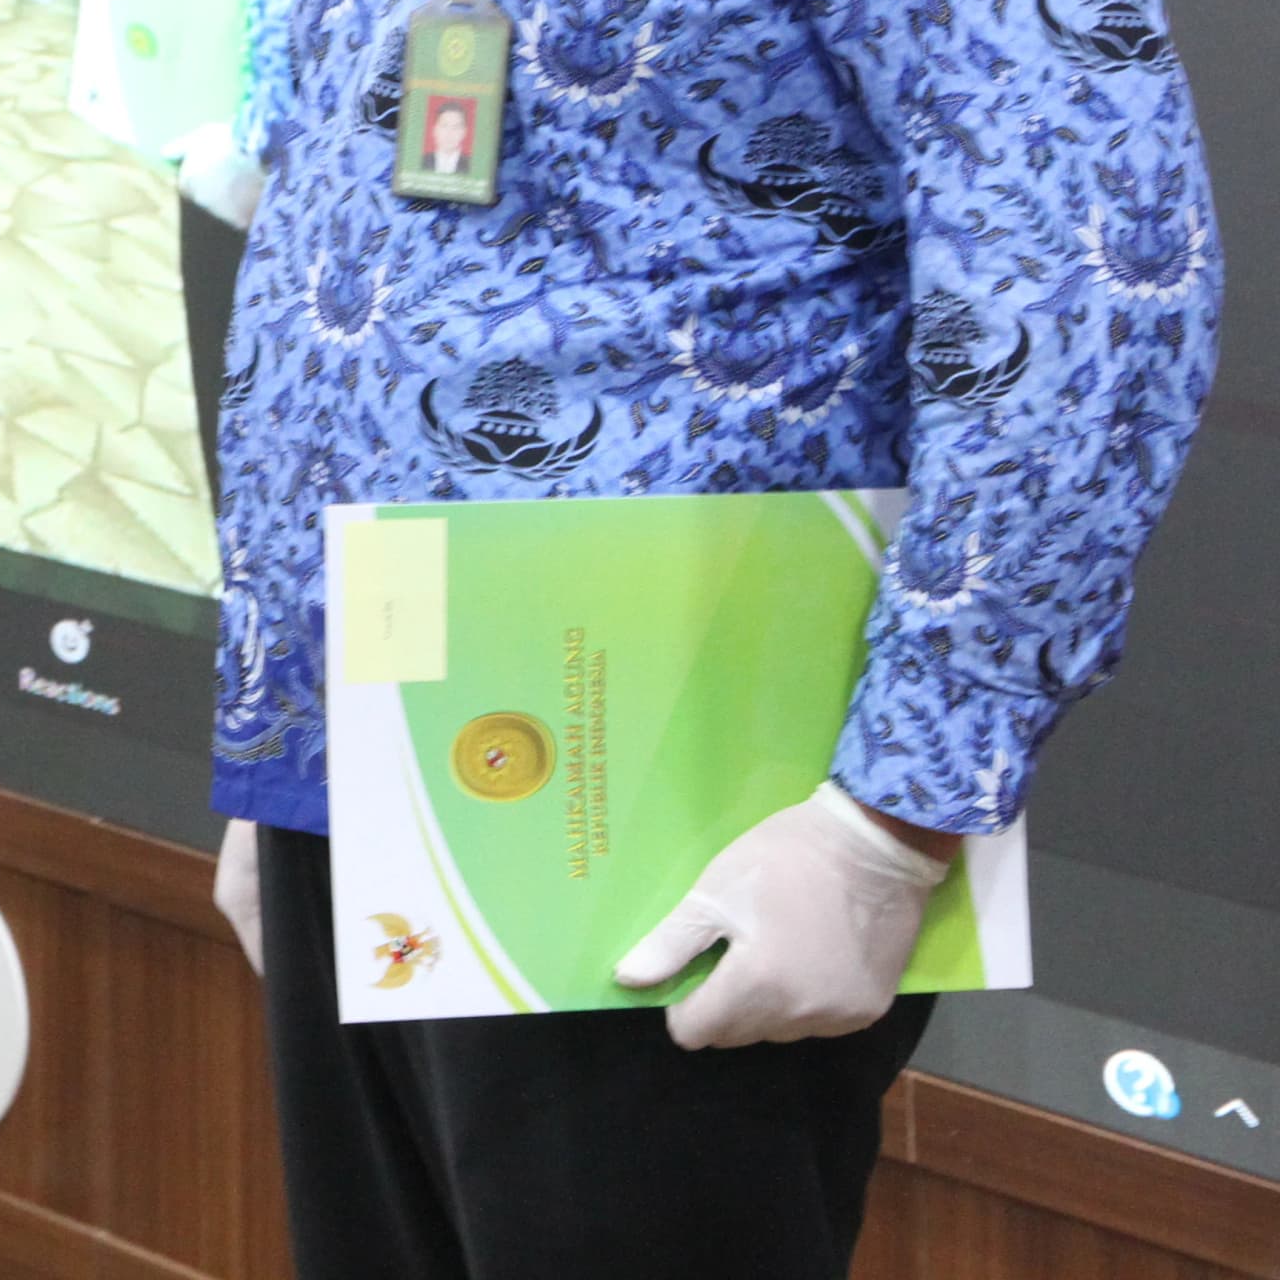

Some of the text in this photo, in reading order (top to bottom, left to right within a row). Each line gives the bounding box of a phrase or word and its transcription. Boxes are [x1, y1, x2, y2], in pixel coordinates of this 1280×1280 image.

[18, 666, 122, 716] Reactions
[563, 626, 588, 881] MAHKAMAH AGUNG
